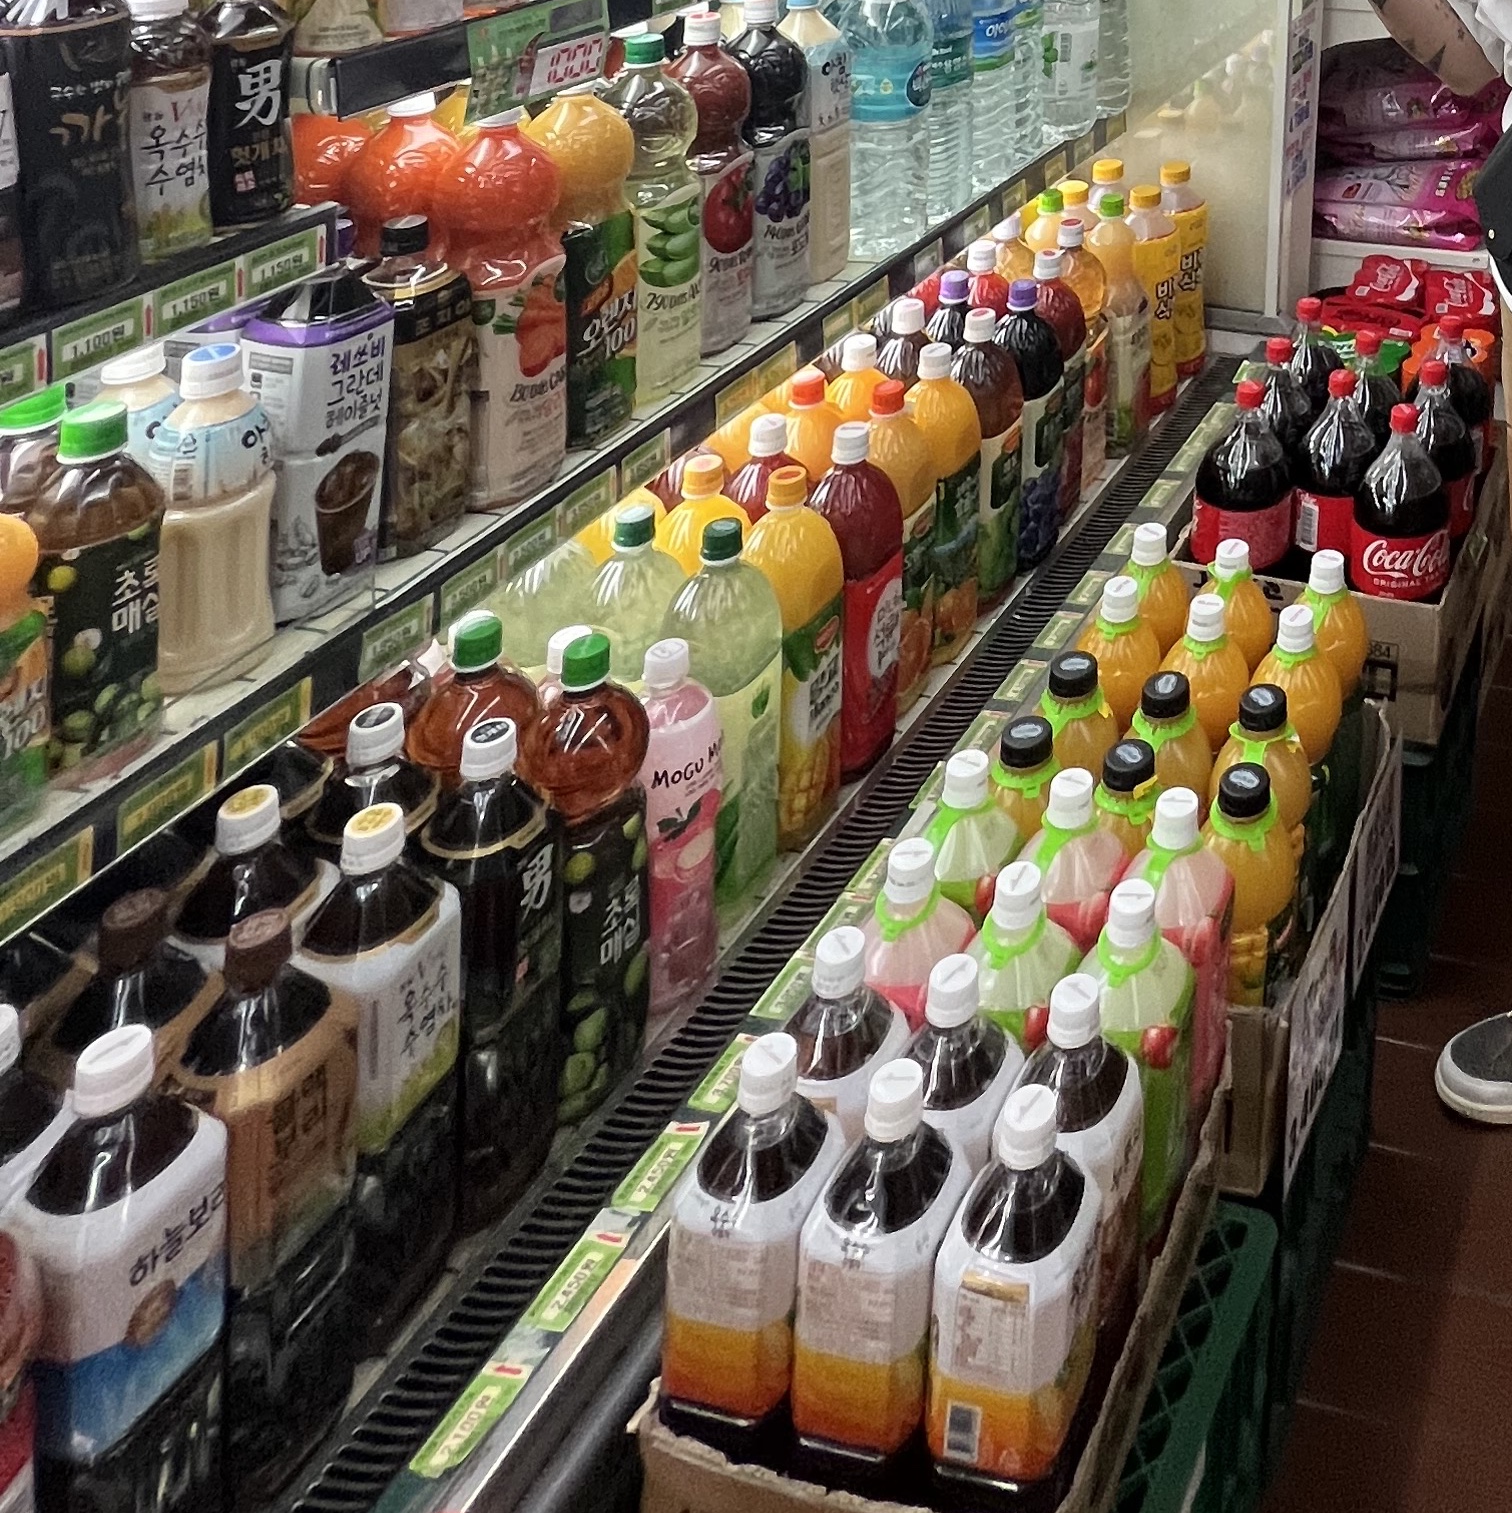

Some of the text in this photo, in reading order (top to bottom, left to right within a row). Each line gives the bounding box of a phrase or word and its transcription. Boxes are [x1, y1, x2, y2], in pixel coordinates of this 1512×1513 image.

[236, 59, 282, 128] 男
[330, 333, 386, 376] 레쓰비
[327, 362, 385, 407] 그란데
[325, 393, 383, 430] 헤이즐넛
[651, 755, 704, 790] MOGU
